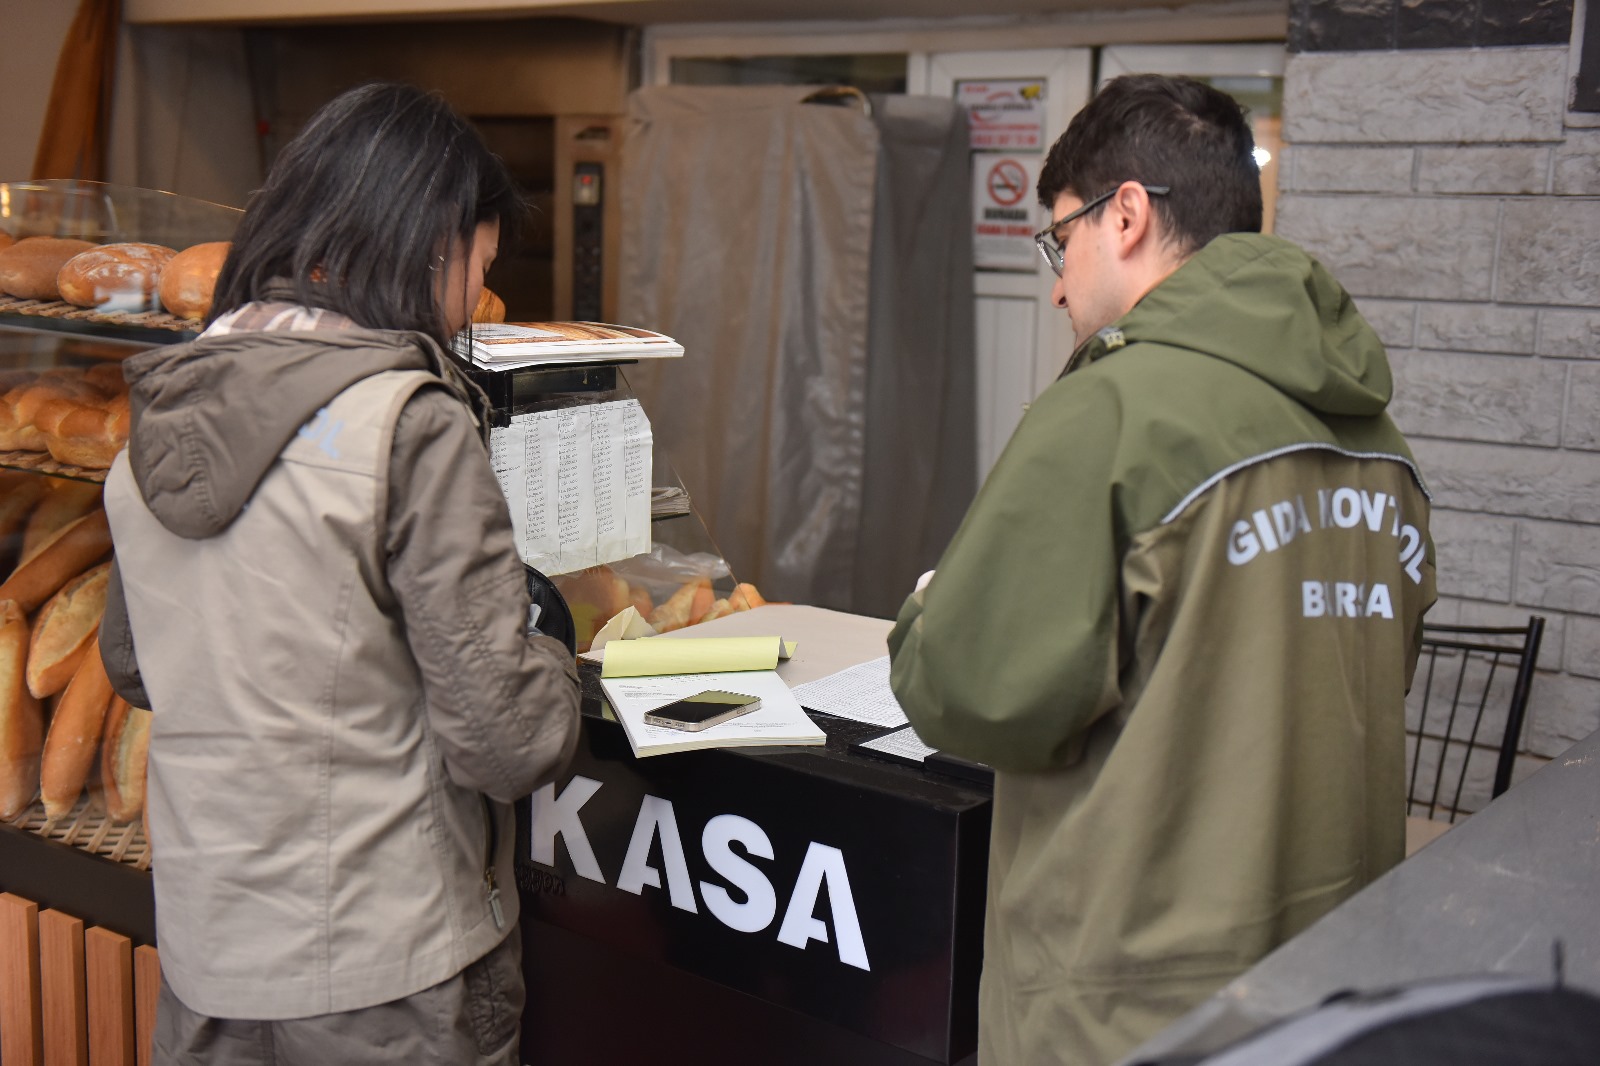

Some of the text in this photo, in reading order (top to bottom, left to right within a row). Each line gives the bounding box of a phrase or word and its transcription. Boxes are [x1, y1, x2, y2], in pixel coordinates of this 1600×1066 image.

[1227, 487, 1427, 585] GIDA KONTOL
[530, 774, 871, 972] KASA
